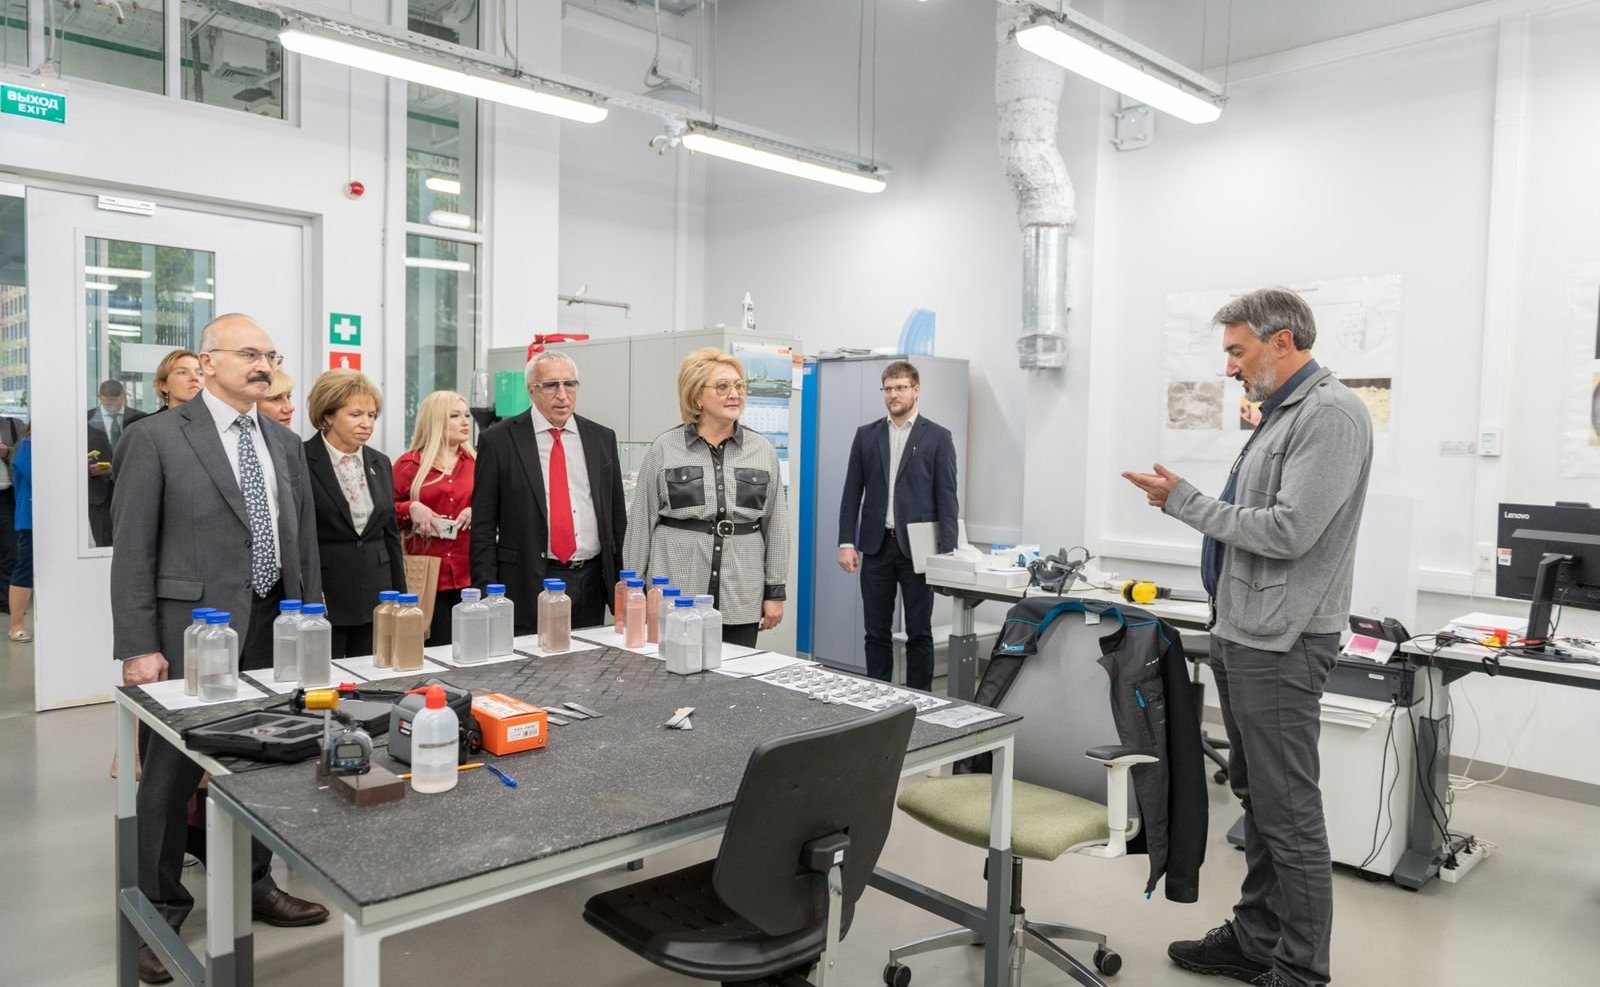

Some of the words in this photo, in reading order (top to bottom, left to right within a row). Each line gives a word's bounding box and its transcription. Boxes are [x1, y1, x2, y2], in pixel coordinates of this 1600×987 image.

[7, 90, 59, 111] ВЫХОД
[18, 103, 48, 116] EXIT
[1504, 511, 1530, 520] Lenovo
